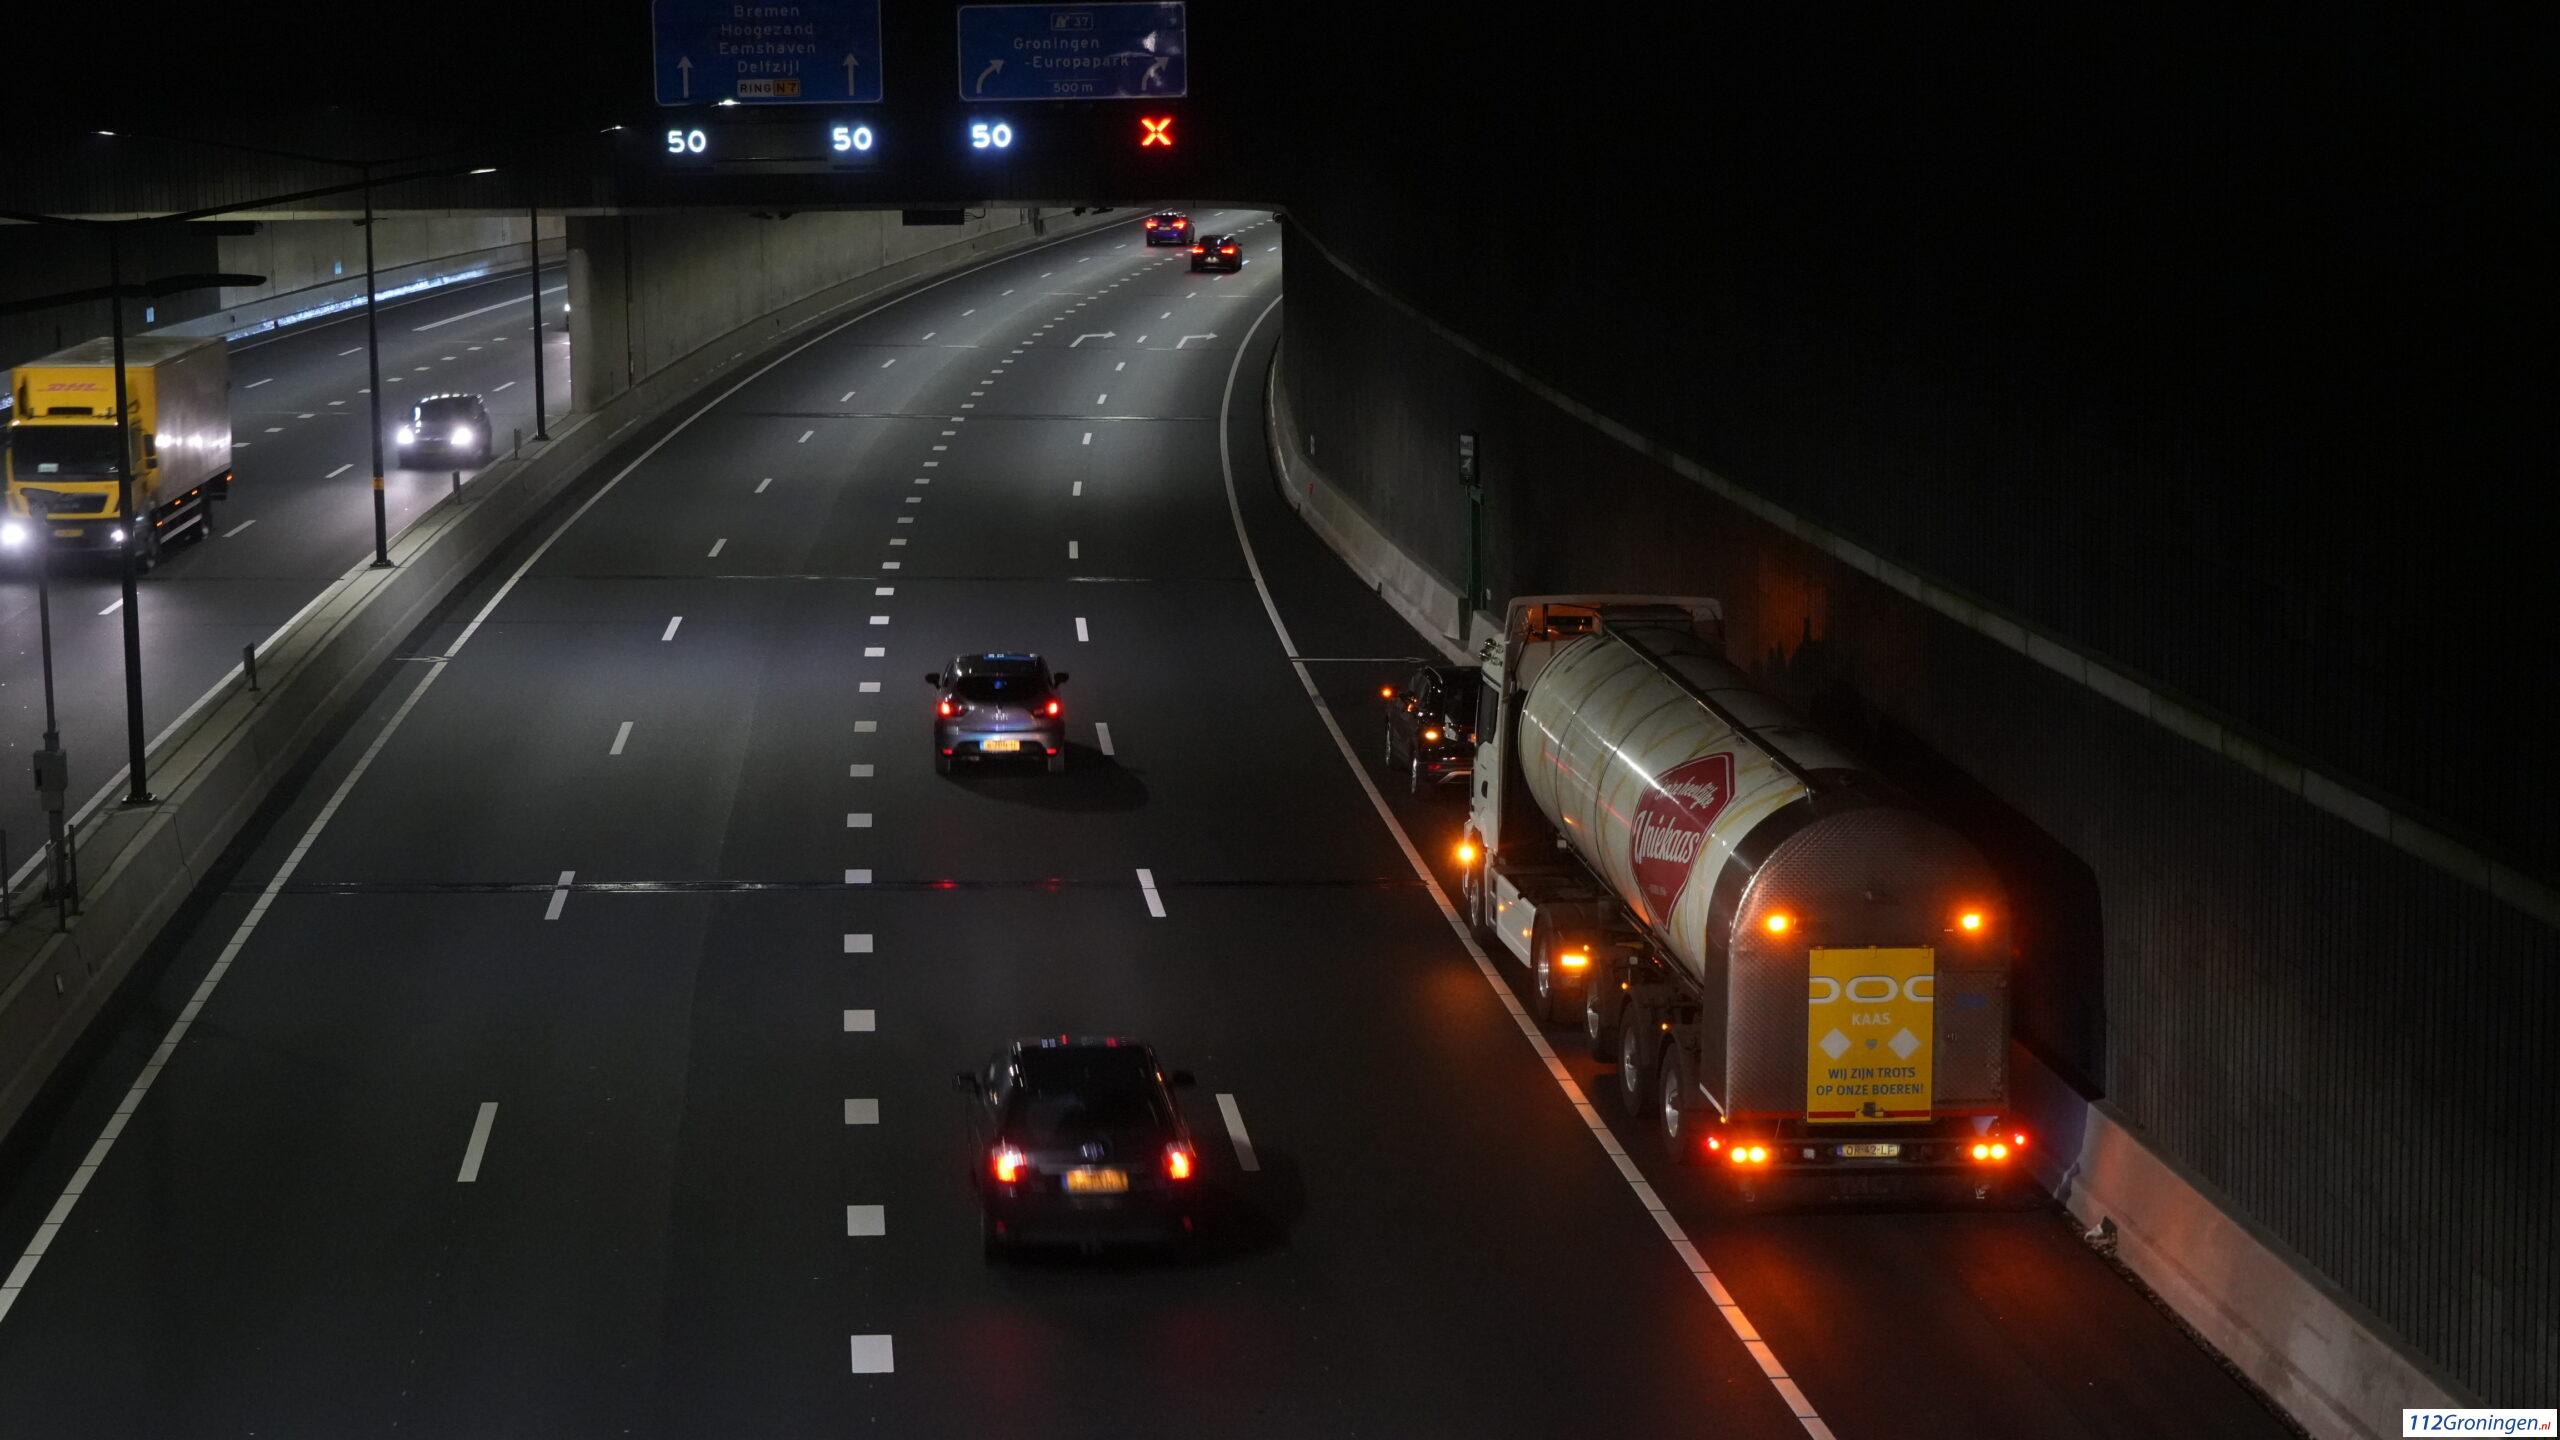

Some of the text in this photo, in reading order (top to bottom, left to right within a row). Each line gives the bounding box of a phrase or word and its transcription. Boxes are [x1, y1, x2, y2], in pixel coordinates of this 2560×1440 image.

[734, 5, 799, 17] Bremen
[721, 23, 814, 38] Hoogezand
[719, 42, 816, 54] Eemshaven
[1013, 38, 1099, 51] Groningen
[738, 60, 800, 76] Delfzijl
[740, 83, 771, 93] RING
[1053, 82, 1093, 93] 500 m
[668, 130, 707, 153] 50
[832, 126, 873, 151] 50
[972, 123, 1012, 148] 50
[1633, 810, 1701, 865] Uniekaas
[1851, 1013, 1892, 1027] KAAS
[1828, 1067, 1916, 1080] WIJ ZIJN TROTS
[1816, 1083, 1924, 1095] OP ONZE BOEREN!
